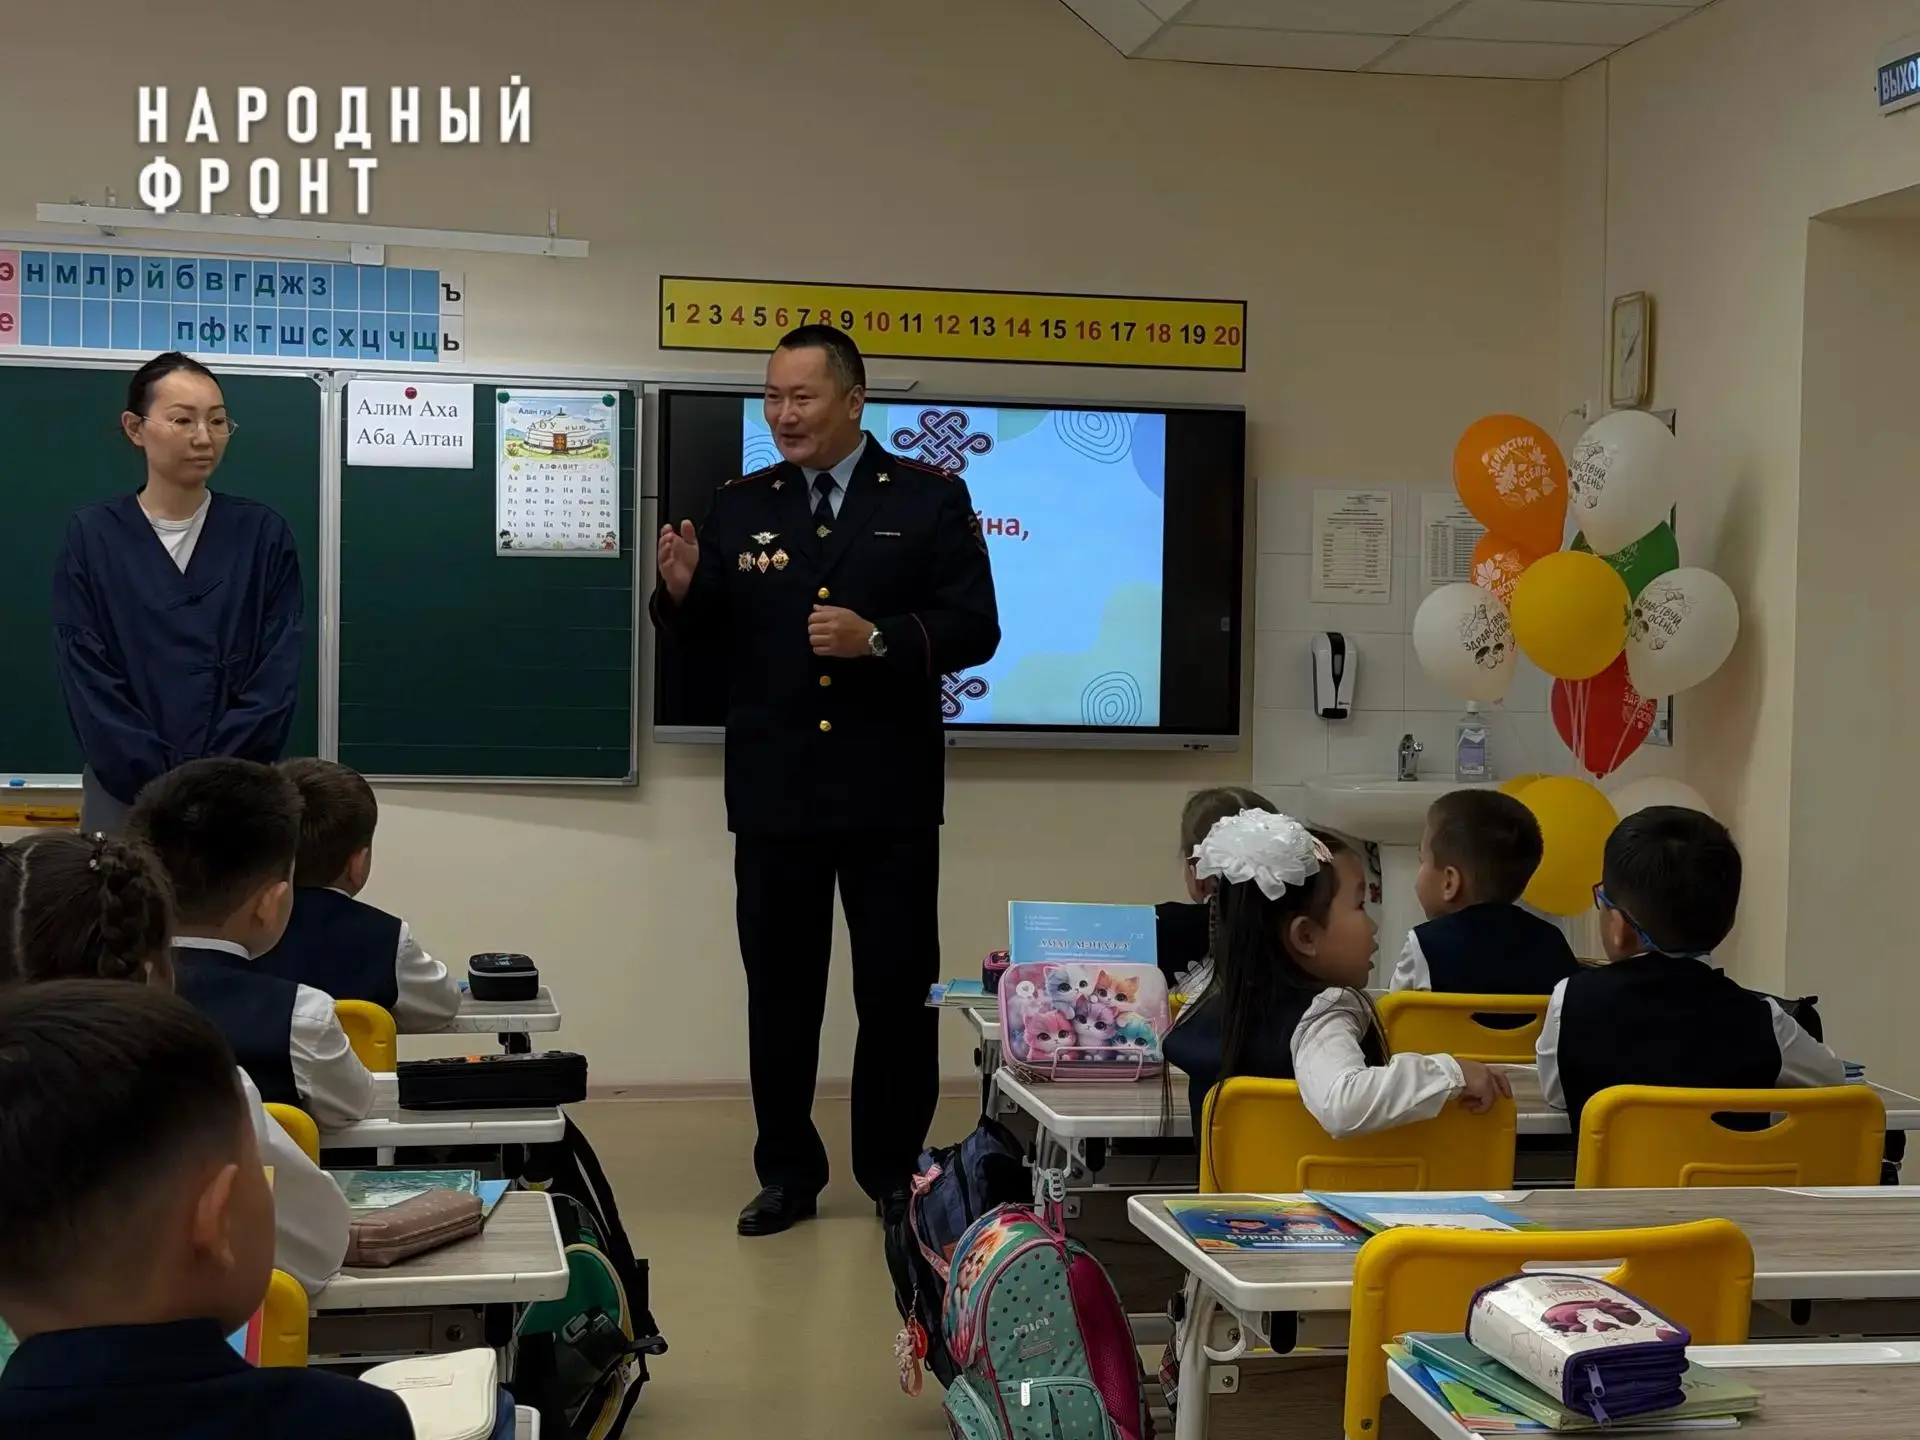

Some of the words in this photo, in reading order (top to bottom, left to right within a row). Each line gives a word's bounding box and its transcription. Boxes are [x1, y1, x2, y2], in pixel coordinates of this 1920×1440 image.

[1881, 57, 1920, 101] ВЫХО
[27, 263, 44, 282] н
[57, 265, 77, 284] м
[86, 267, 105, 285] л
[117, 268, 134, 292] р
[148, 263, 164, 289] й
[176, 264, 194, 289] б
[206, 272, 223, 291] в
[234, 274, 247, 292] г
[255, 275, 275, 298] д
[281, 276, 303, 295] ж
[312, 277, 326, 295] з
[177, 321, 193, 340] п
[200, 317, 225, 347] ф
[234, 324, 248, 343] к
[256, 325, 272, 343] т
[281, 327, 304, 345] ш
[312, 328, 328, 346] с
[338, 329, 355, 347] х
[362, 330, 380, 352] ц
[389, 331, 404, 349] ч
[414, 332, 437, 354] щ
[665, 302, 675, 322] 1
[686, 304, 700, 323] 2
[709, 305, 722, 324] 3
[730, 306, 744, 325] 4
[753, 307, 767, 326] 5
[775, 308, 789, 327] 6
[797, 309, 810, 327] 7
[819, 309, 832, 326] 8
[841, 310, 853, 330] 9
[864, 312, 890, 332] 10
[900, 313, 922, 332] 11
[934, 315, 960, 335] 12
[970, 316, 996, 336] 13
[1005, 318, 1031, 337] 14
[1040, 319, 1066, 339] 15
[1075, 320, 1102, 340] 16
[1110, 322, 1136, 342] 17
[1146, 324, 1171, 343] 18
[1180, 324, 1206, 344] 19
[1214, 326, 1240, 346] 20
[357, 399, 412, 416] Алим
[420, 401, 458, 417] Аха
[357, 428, 395, 445] Аба
[402, 430, 463, 446] Алтан
